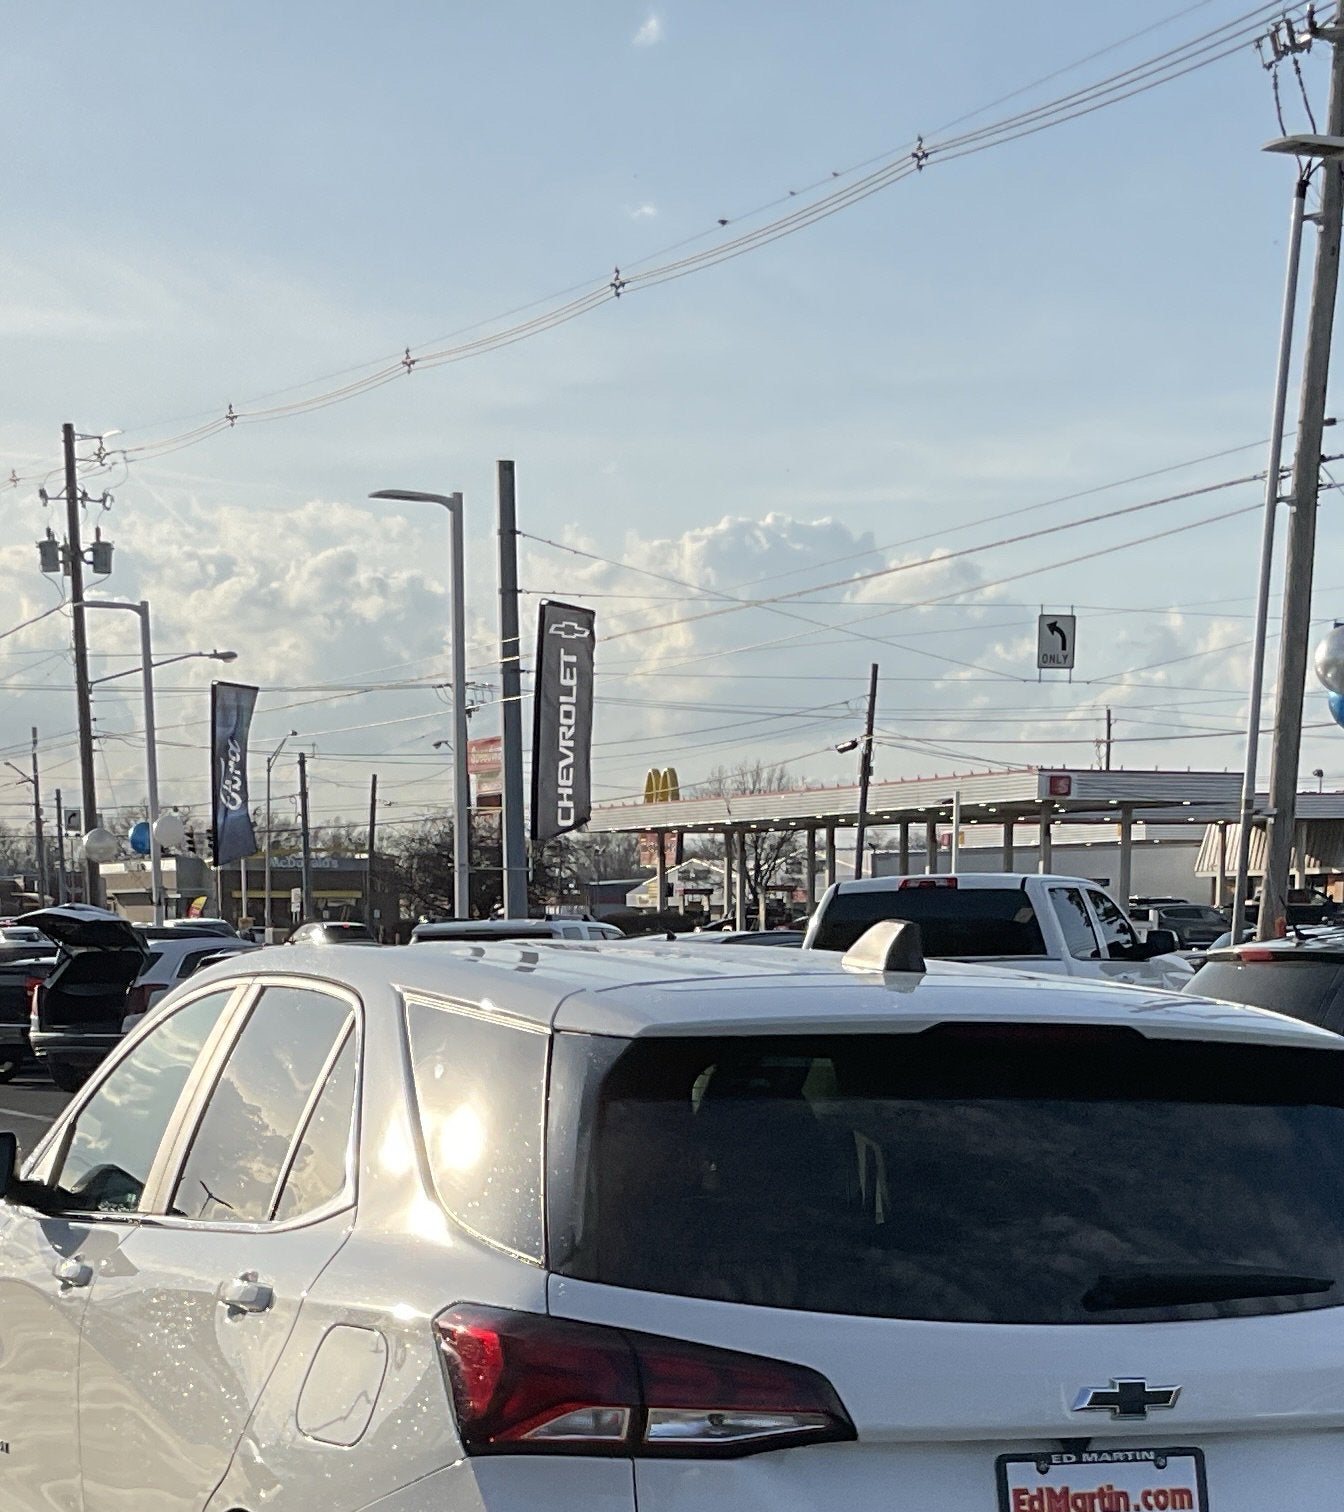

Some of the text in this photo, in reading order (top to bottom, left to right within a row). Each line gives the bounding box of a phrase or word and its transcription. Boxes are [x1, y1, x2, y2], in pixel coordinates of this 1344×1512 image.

[1042, 654, 1068, 664] ONLY
[557, 648, 577, 827] CHEVROLET
[220, 738, 243, 811] Ford
[270, 856, 338, 868] McDoald's
[1051, 1451, 1155, 1464] ED MARTIN
